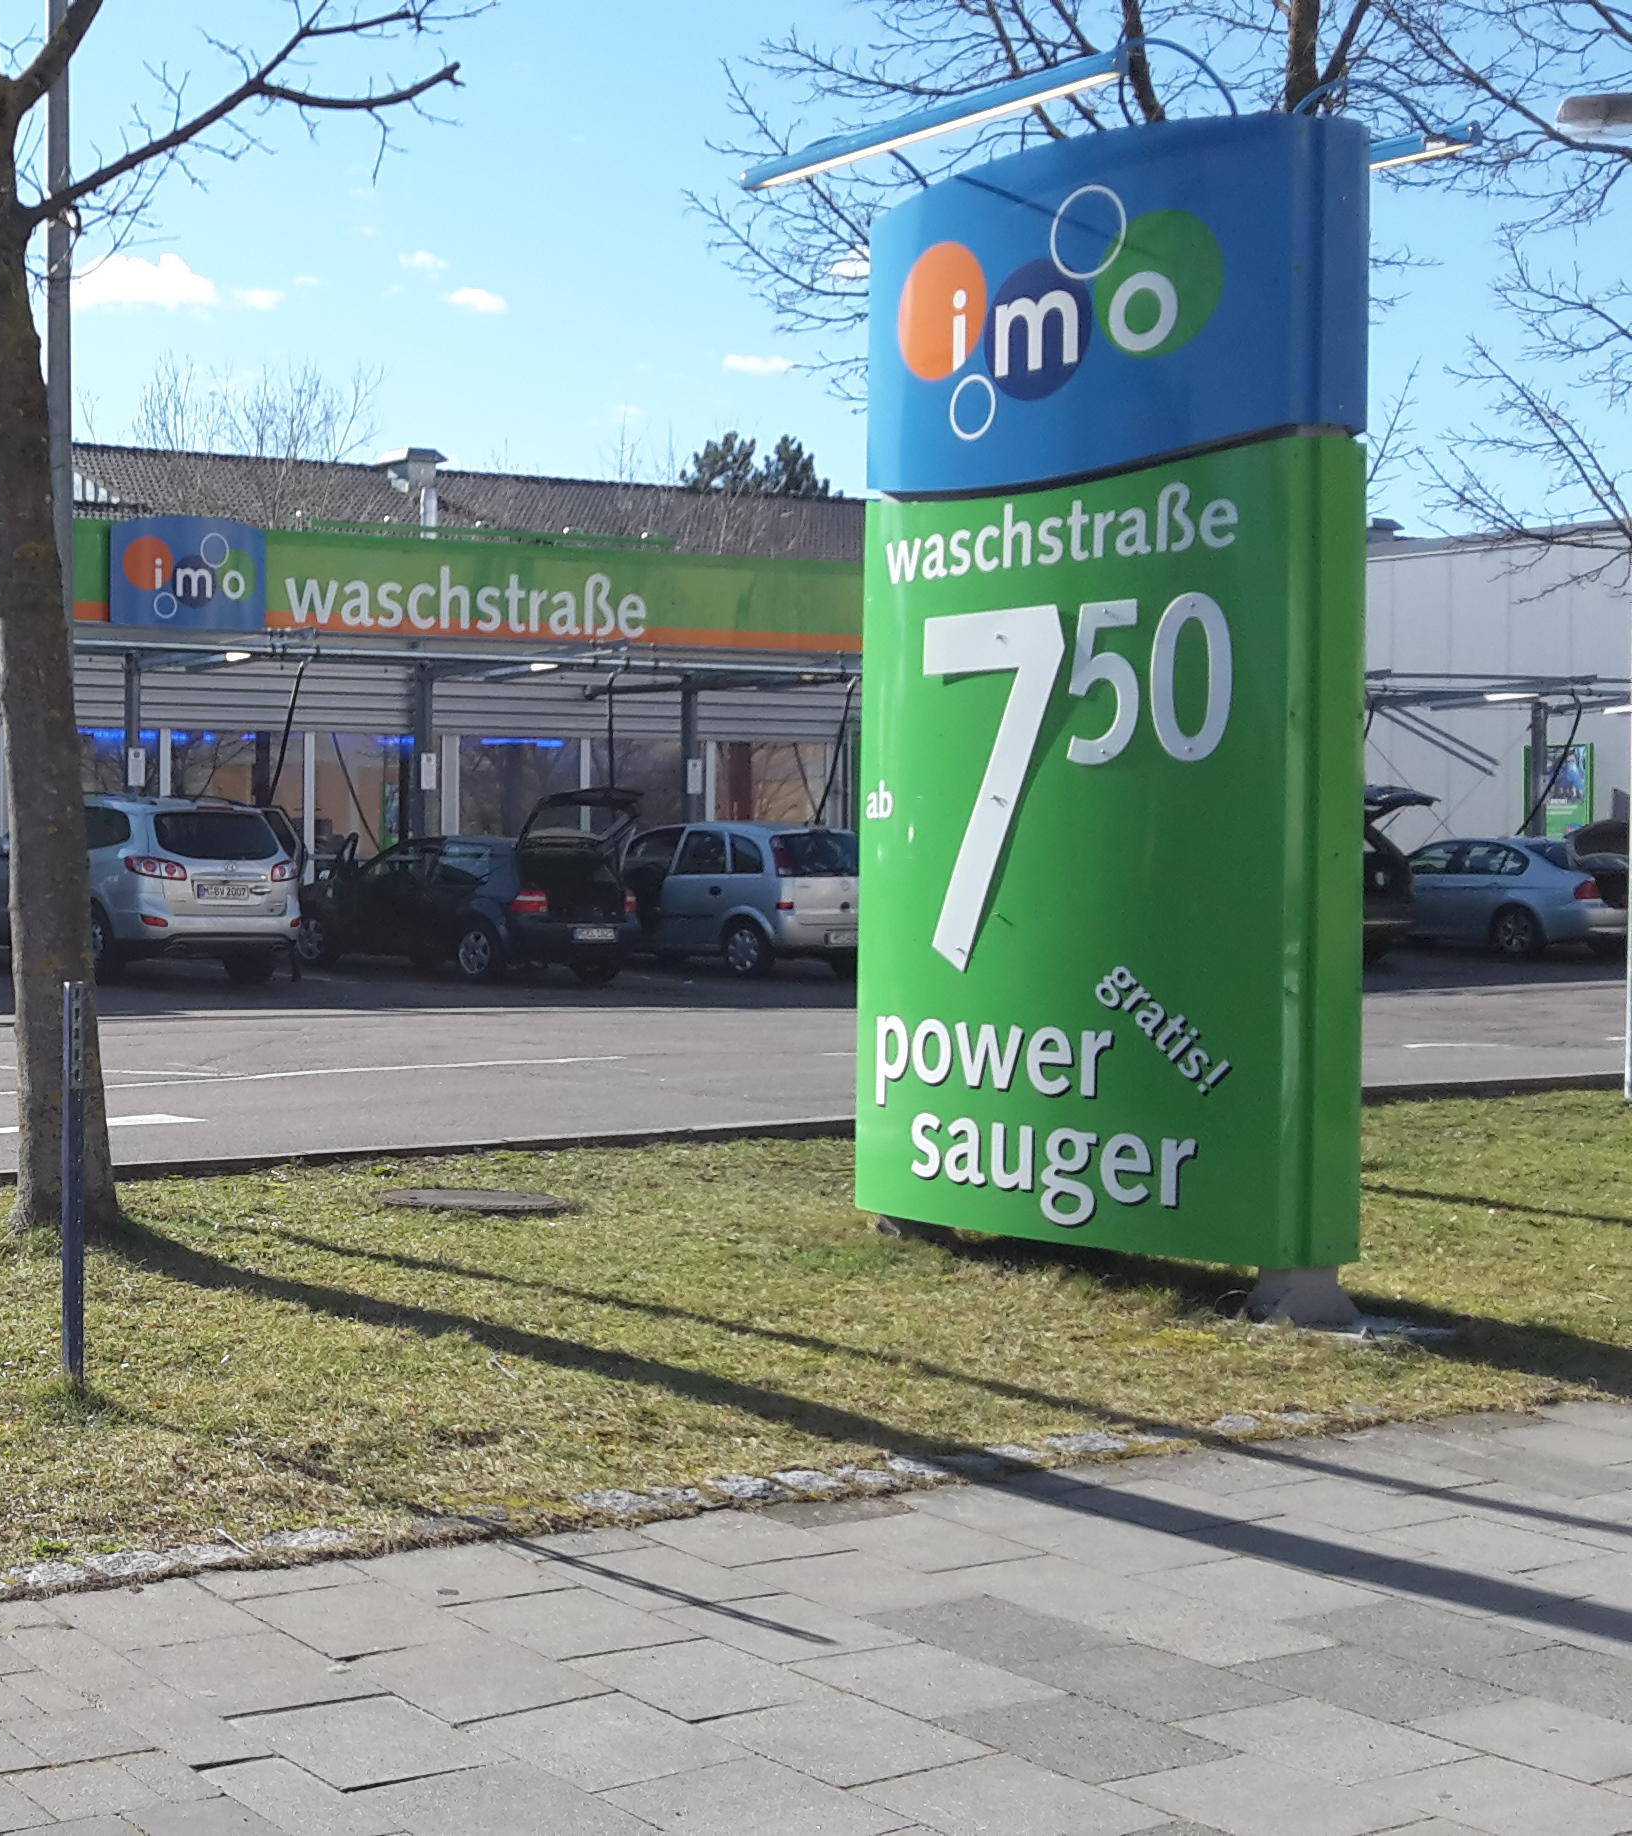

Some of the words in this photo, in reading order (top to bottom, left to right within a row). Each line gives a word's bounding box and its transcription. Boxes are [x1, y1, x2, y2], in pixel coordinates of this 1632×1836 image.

[952, 271, 1179, 380] imo
[154, 557, 246, 600] imo
[886, 481, 1240, 585] waschstraße
[284, 565, 647, 638] waschstraße
[865, 780, 894, 820] ab
[875, 1013, 1115, 1105] power
[1094, 965, 1234, 1096] gratis!
[911, 1110, 1199, 1227] sauger
